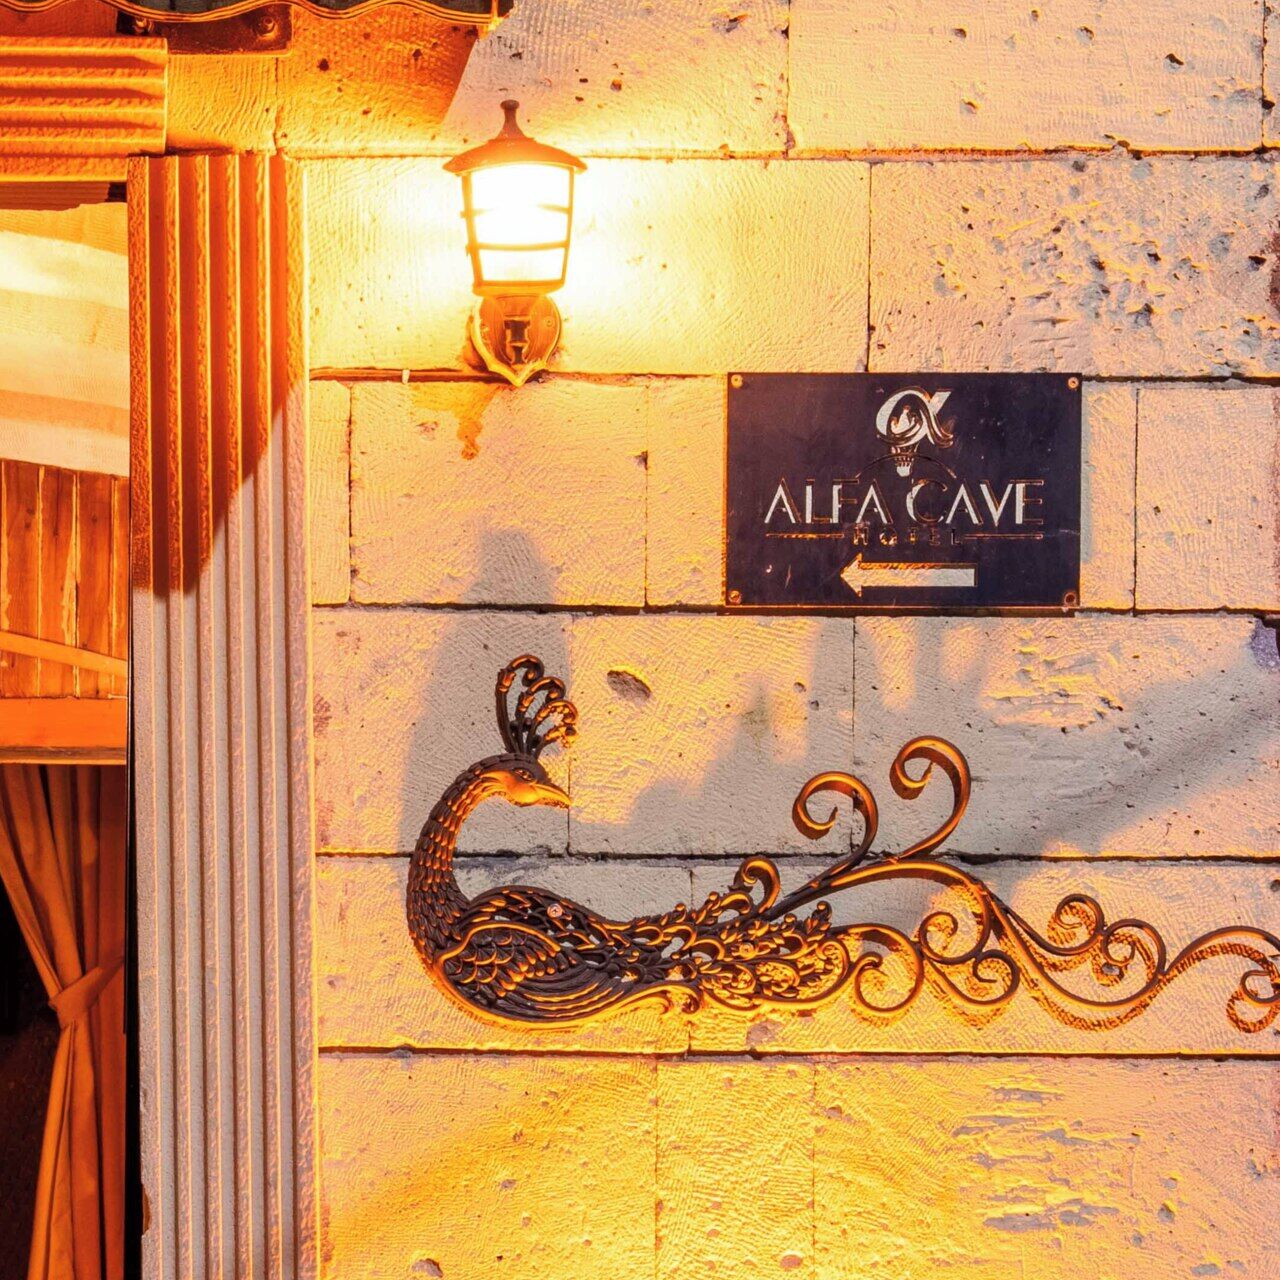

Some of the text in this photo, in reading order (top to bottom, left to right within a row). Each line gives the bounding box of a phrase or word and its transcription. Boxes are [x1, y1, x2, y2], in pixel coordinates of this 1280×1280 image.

[764, 477, 1044, 527] ALFA CAVE
[852, 526, 962, 546] HOTEL
